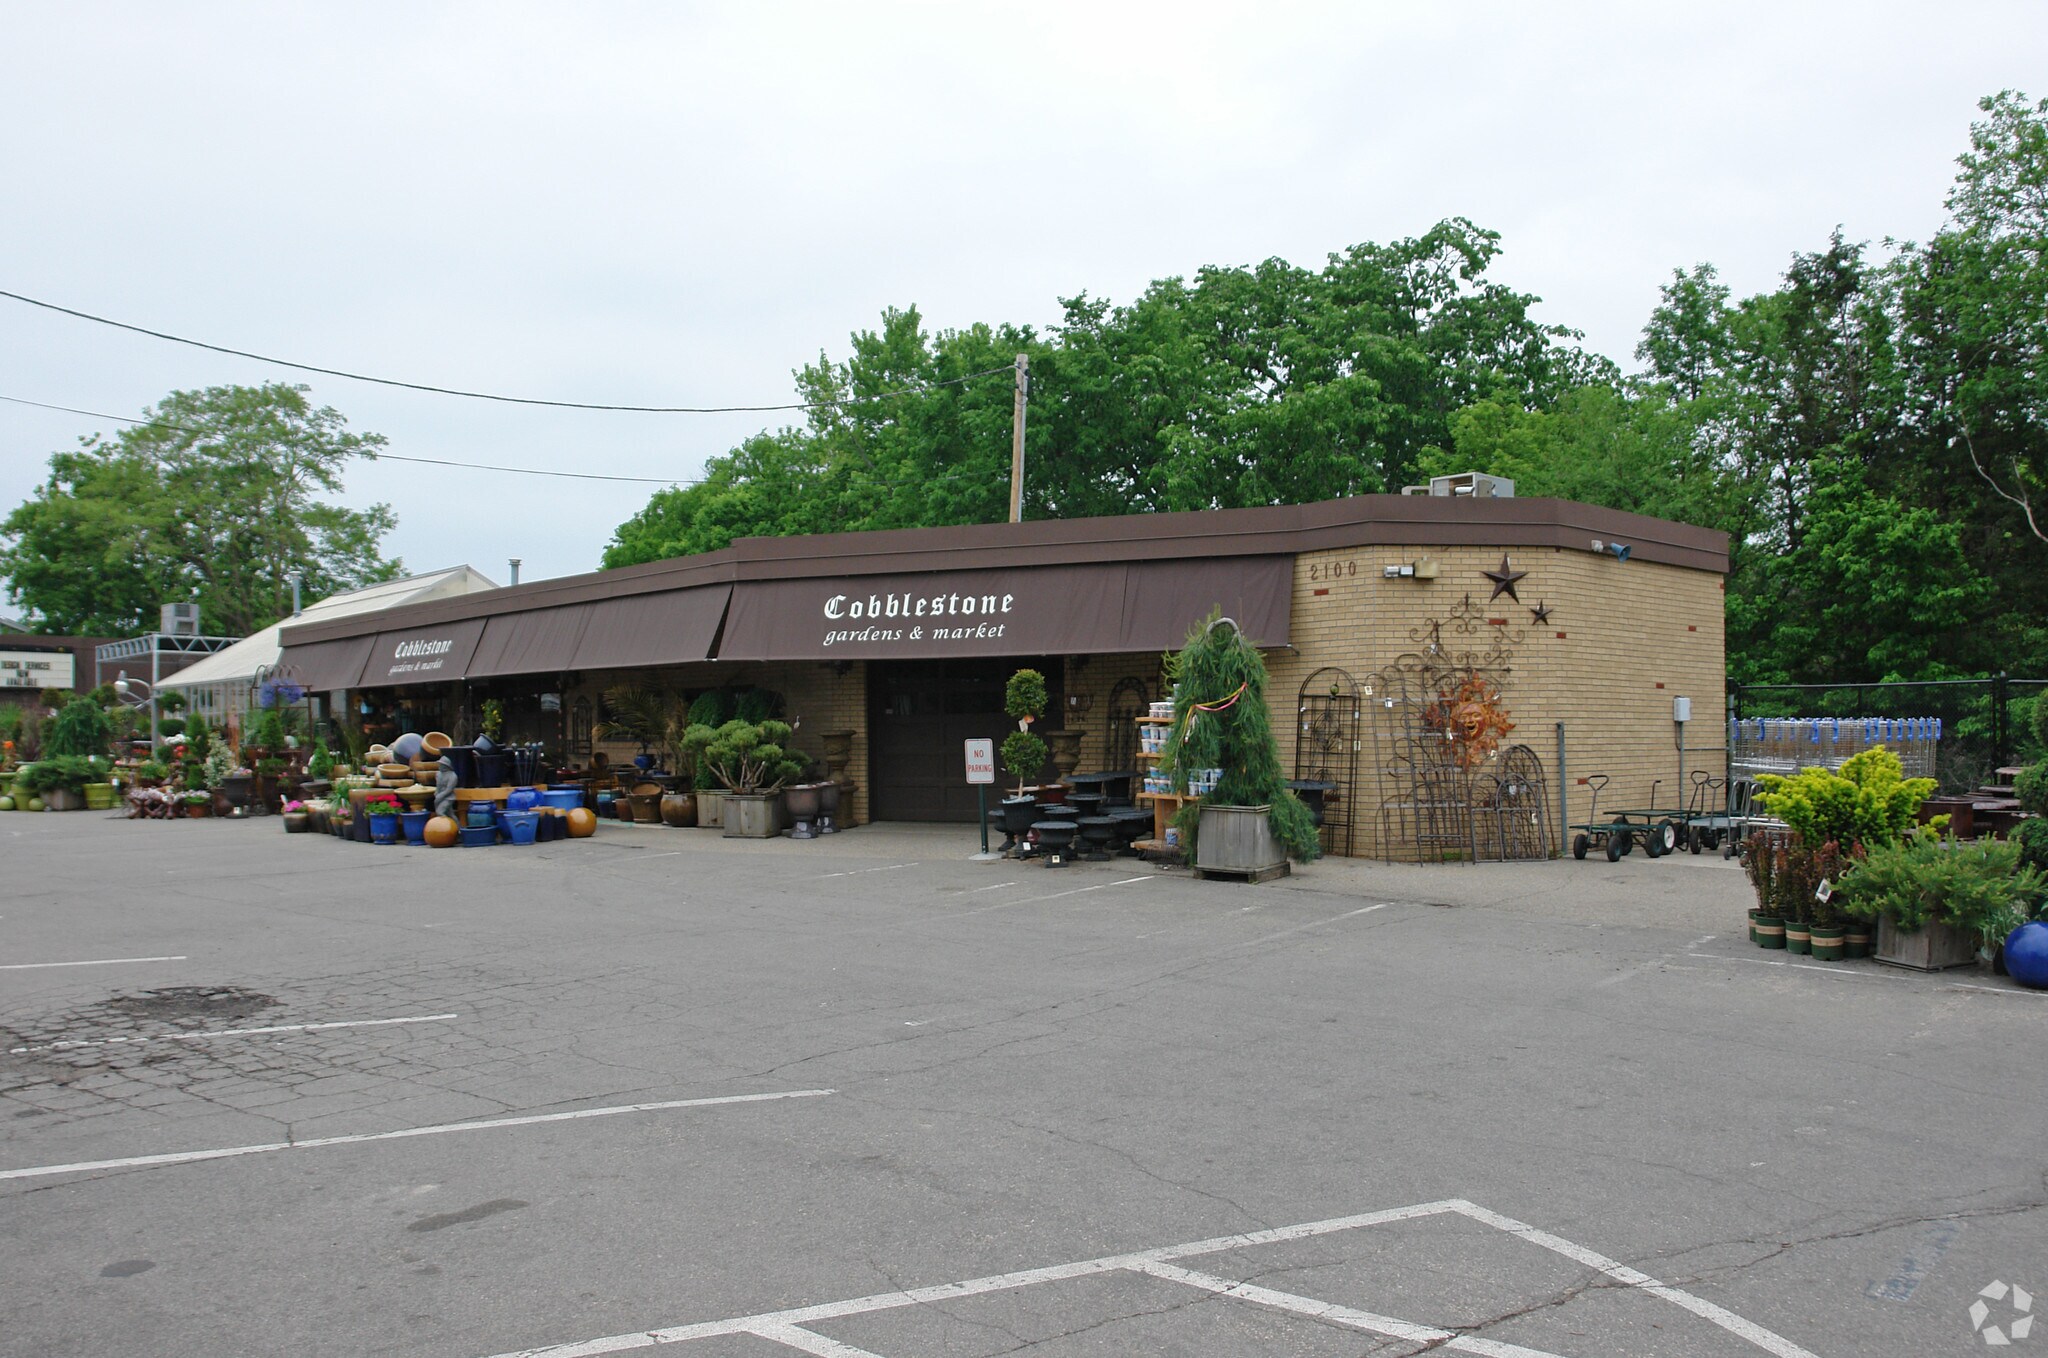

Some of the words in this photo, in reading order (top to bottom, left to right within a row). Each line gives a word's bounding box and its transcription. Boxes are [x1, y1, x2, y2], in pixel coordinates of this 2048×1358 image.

[1310, 561, 1356, 580] 2100
[824, 592, 1014, 619] Cobblestone
[823, 626, 902, 646] gardens
[909, 625, 923, 640] &
[932, 622, 1006, 640] market
[395, 640, 452, 658] Cobblestone
[388, 661, 414, 676] gardens
[421, 658, 443, 670] market
[973, 750, 984, 758] NO
[967, 764, 993, 772] PARKING
